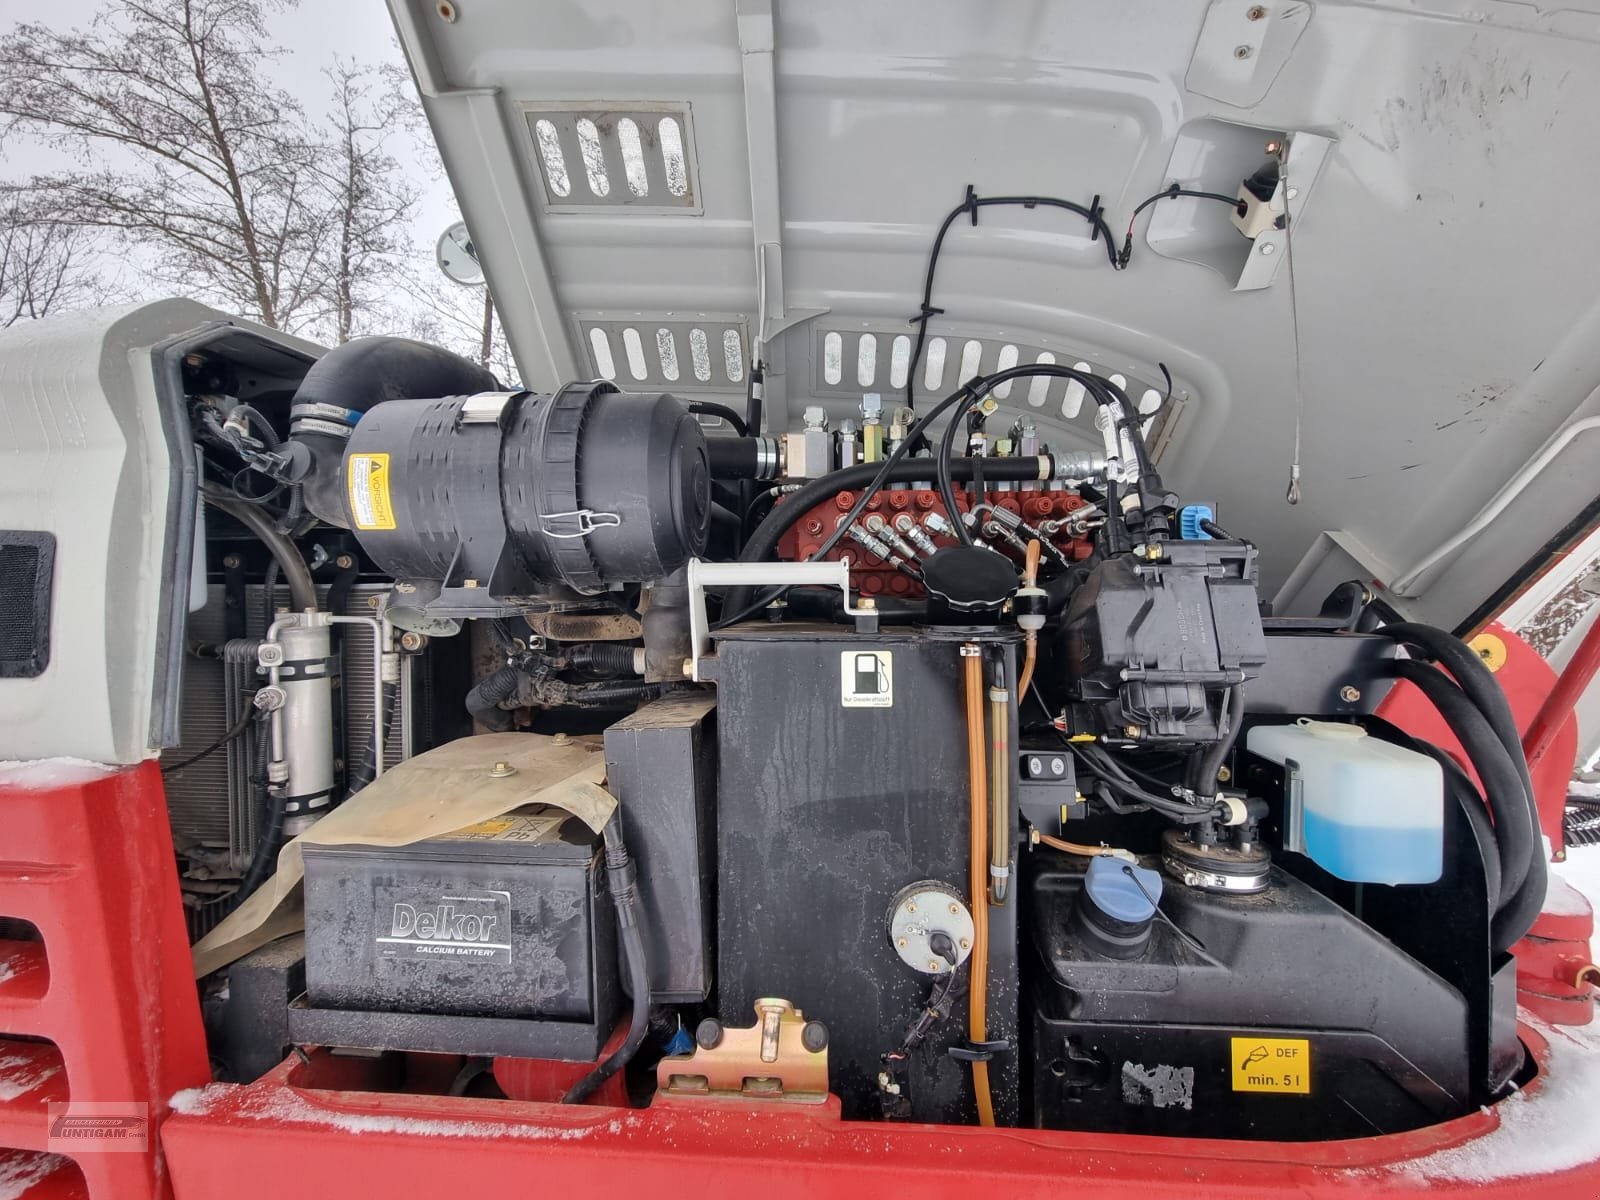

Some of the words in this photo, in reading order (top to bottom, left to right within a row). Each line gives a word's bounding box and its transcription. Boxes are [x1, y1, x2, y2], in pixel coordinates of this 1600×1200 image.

[391, 903, 497, 941] Delkor
[416, 946, 455, 955] CALCIUM
[456, 948, 496, 957] BATTERY
[1276, 1048, 1299, 1058] DEF
[1248, 1074, 1279, 1086] min.
[1283, 1074, 1292, 1086] 5
